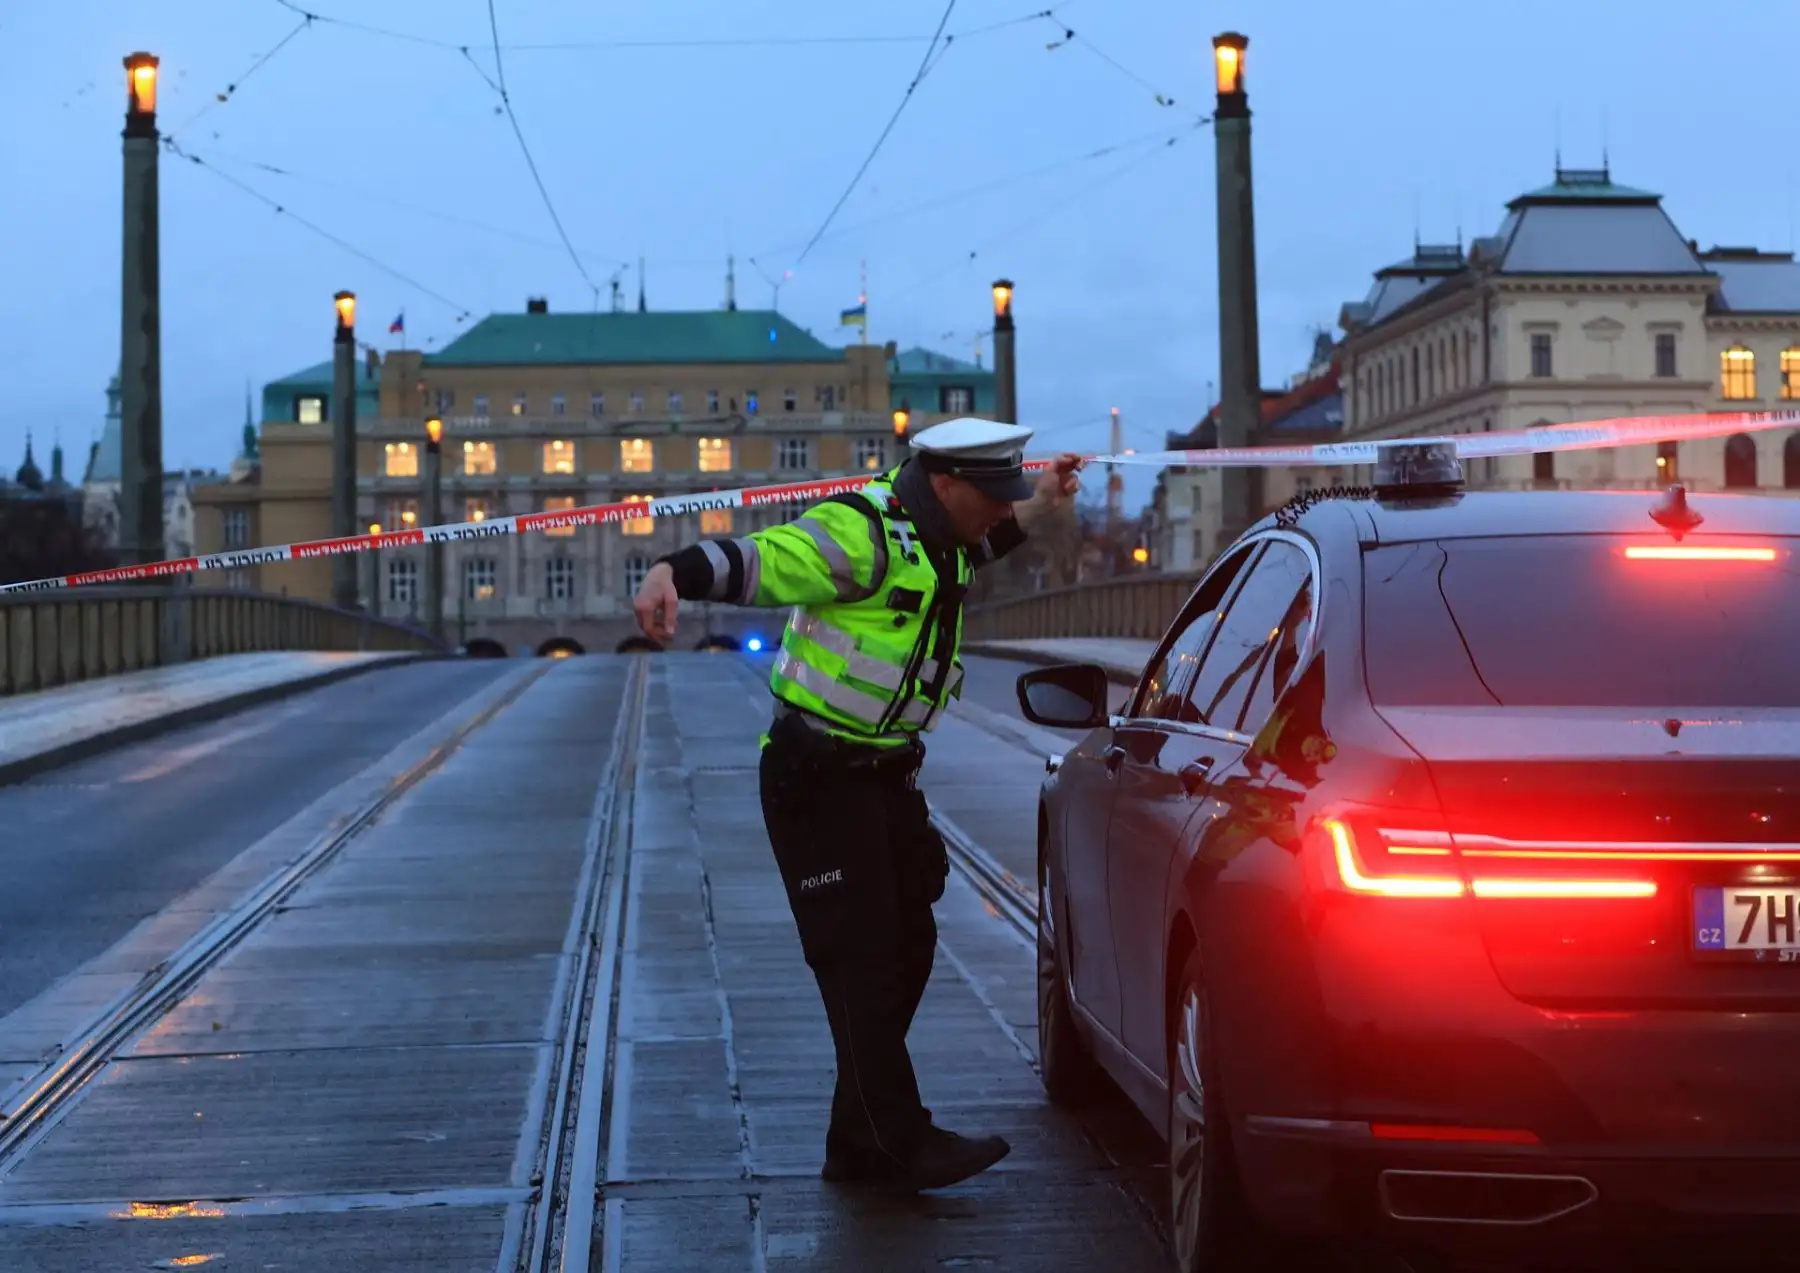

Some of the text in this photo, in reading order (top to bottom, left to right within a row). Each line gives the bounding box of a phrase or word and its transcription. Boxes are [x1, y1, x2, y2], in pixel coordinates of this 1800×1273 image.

[801, 868, 843, 890] POLICIE
[1734, 894, 1800, 944] 7H
[1698, 928, 1721, 944] CZ
